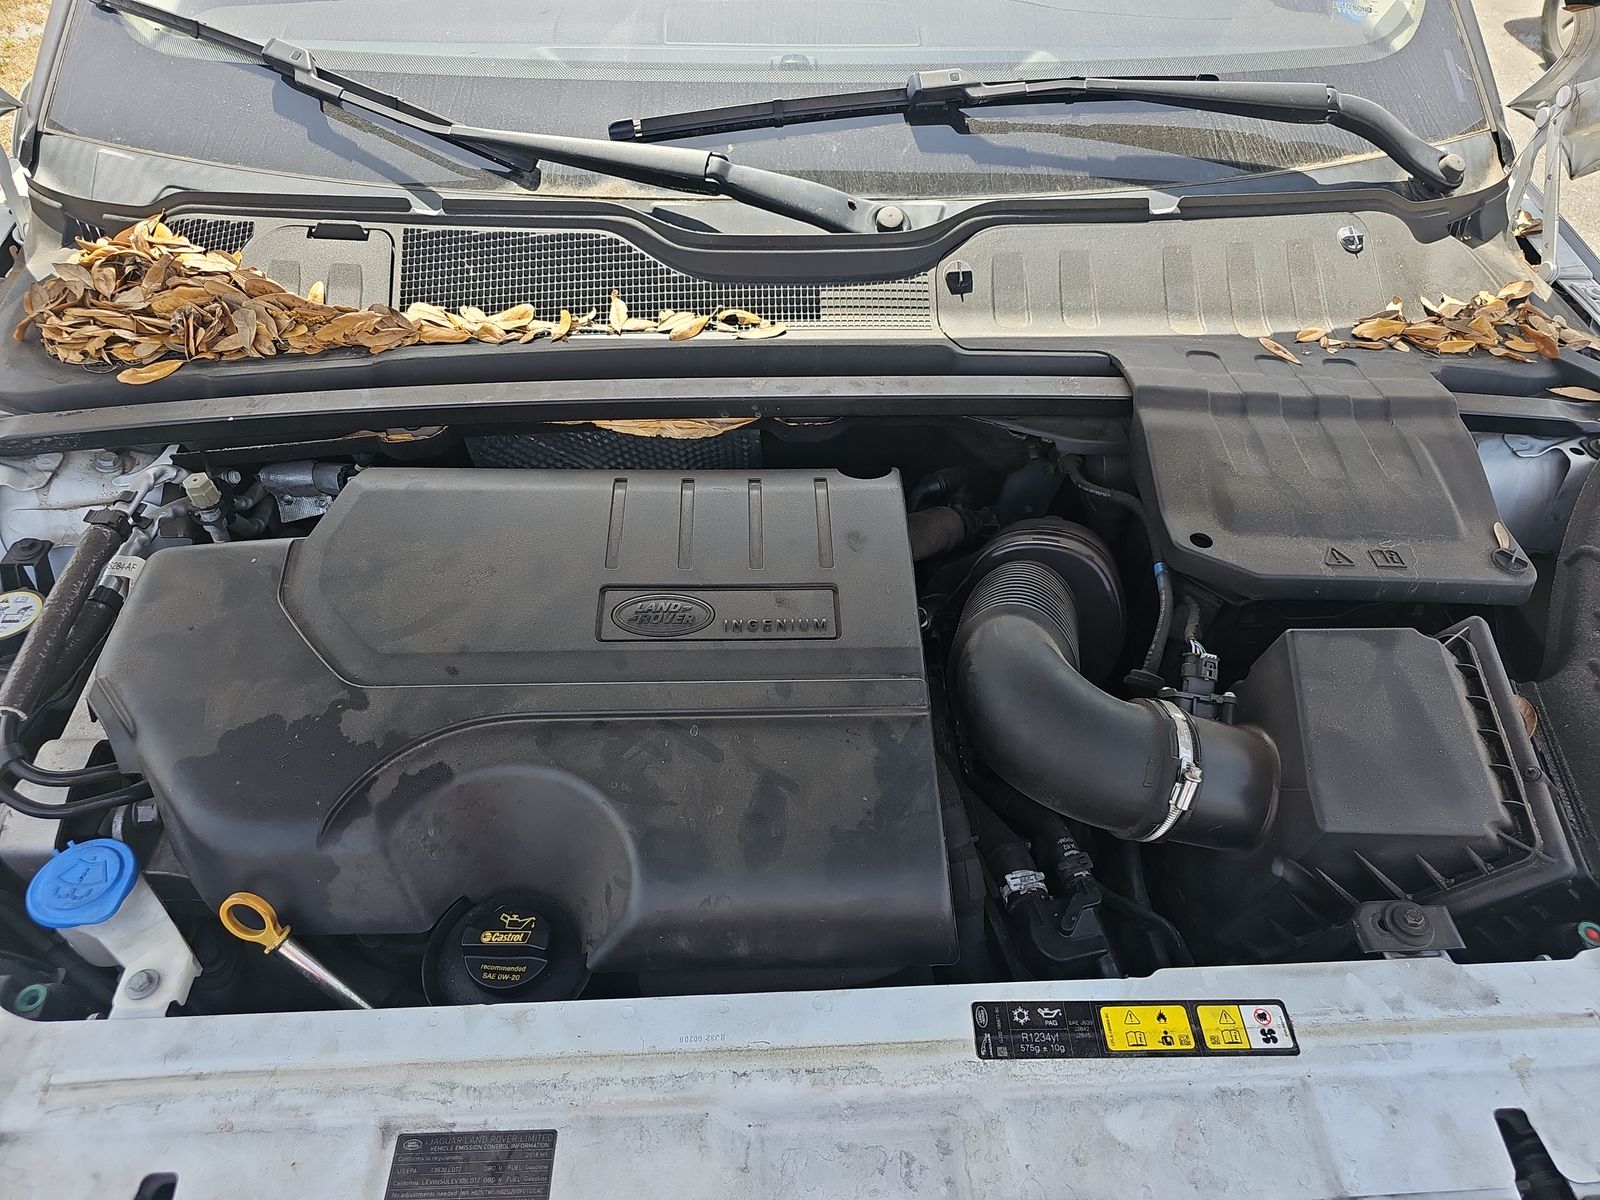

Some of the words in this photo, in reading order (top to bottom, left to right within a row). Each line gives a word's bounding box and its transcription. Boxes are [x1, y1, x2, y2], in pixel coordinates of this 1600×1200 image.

[723, 618, 828, 633] INGENIUM
[491, 932, 524, 942] Castrol
[480, 963, 527, 972] recommended
[482, 972, 497, 980] SAE
[497, 973, 521, 981] 0W-20
[1021, 1032, 1060, 1044] R1234yf
[1020, 1044, 1041, 1054] 575g
[1051, 1044, 1066, 1053] 10g
[429, 1136, 463, 1146] JAGUAR
[464, 1135, 488, 1144] LAND
[490, 1134, 518, 1143] ROVER
[519, 1133, 553, 1143] LIMITED
[400, 1191, 435, 1199] adjustments
